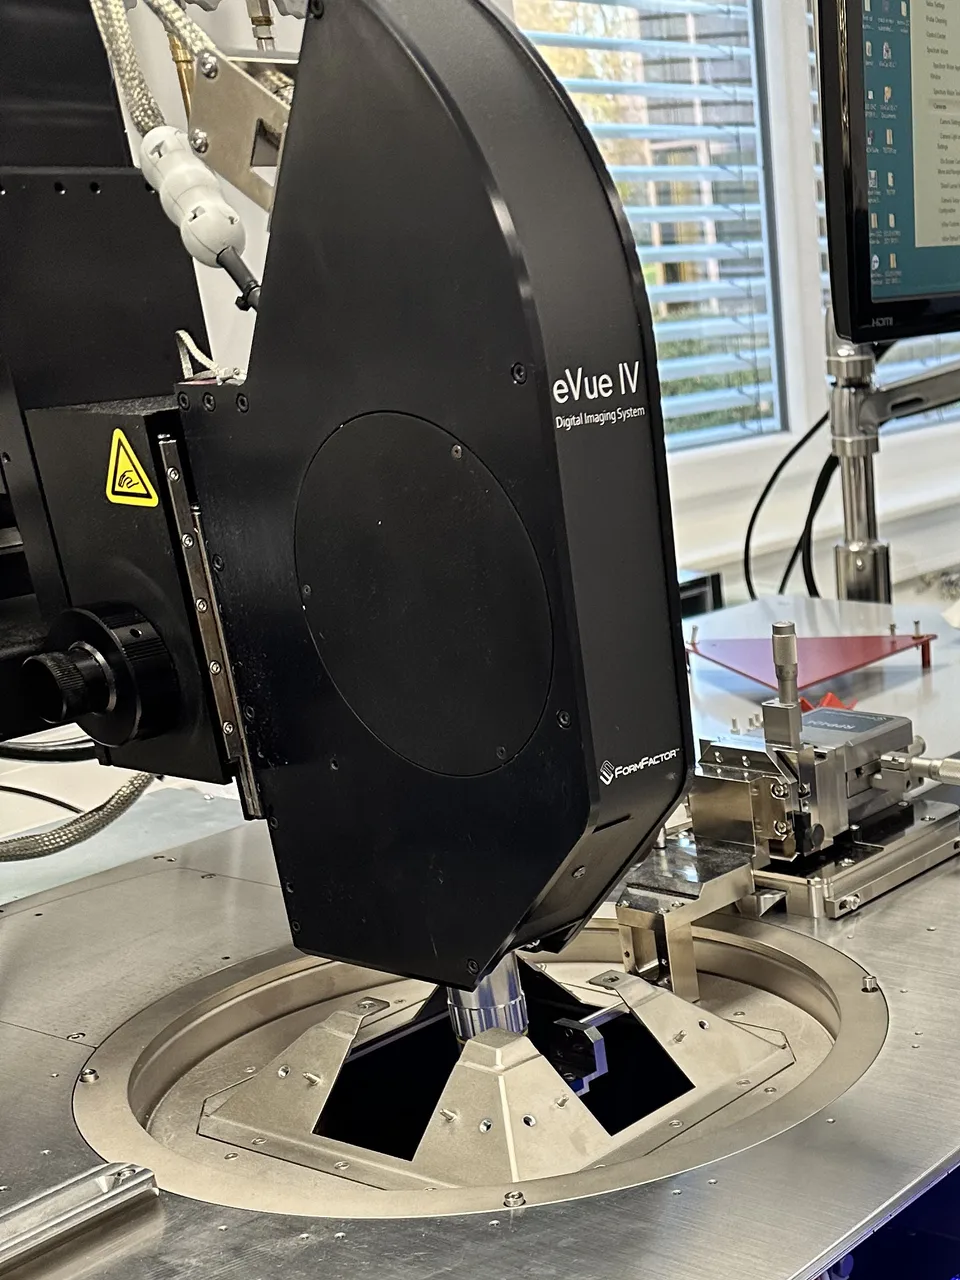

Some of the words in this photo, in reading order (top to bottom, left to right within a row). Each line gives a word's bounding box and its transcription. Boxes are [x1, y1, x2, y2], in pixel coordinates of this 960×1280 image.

[552, 366, 613, 404] eVue
[618, 360, 640, 394] IV
[555, 411, 583, 431] Digital
[584, 409, 617, 427] Imaging
[616, 406, 645, 422] System
